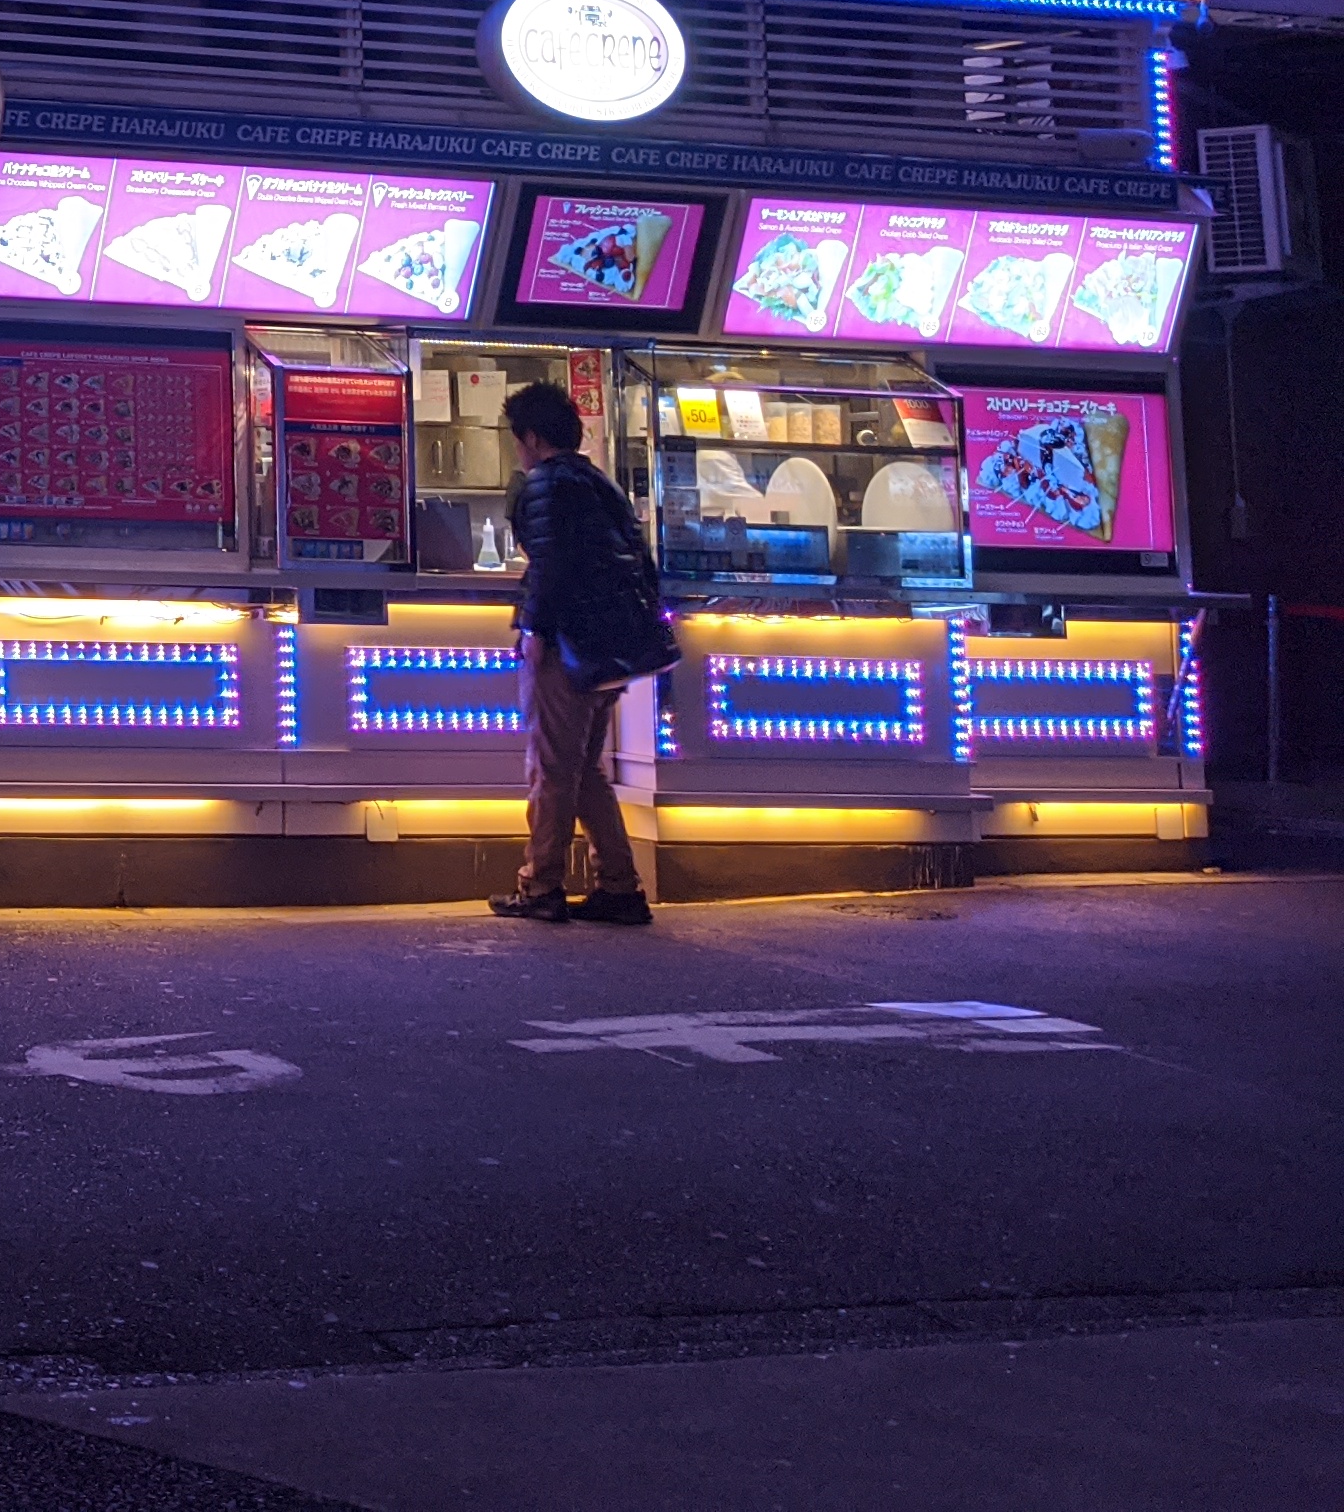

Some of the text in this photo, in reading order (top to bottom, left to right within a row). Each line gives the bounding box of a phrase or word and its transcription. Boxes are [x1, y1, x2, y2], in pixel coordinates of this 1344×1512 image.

[4, 109, 1173, 199] FE CREPE HARAJUKU CAFE CREPE HARAJUKU CAFE CREPE CAFE CREPE HARAJUKU CAFE CREPE HARAJUKU CAFE CREPE
[985, 396, 1118, 416] ストロベリーチョコチーズケーキ
